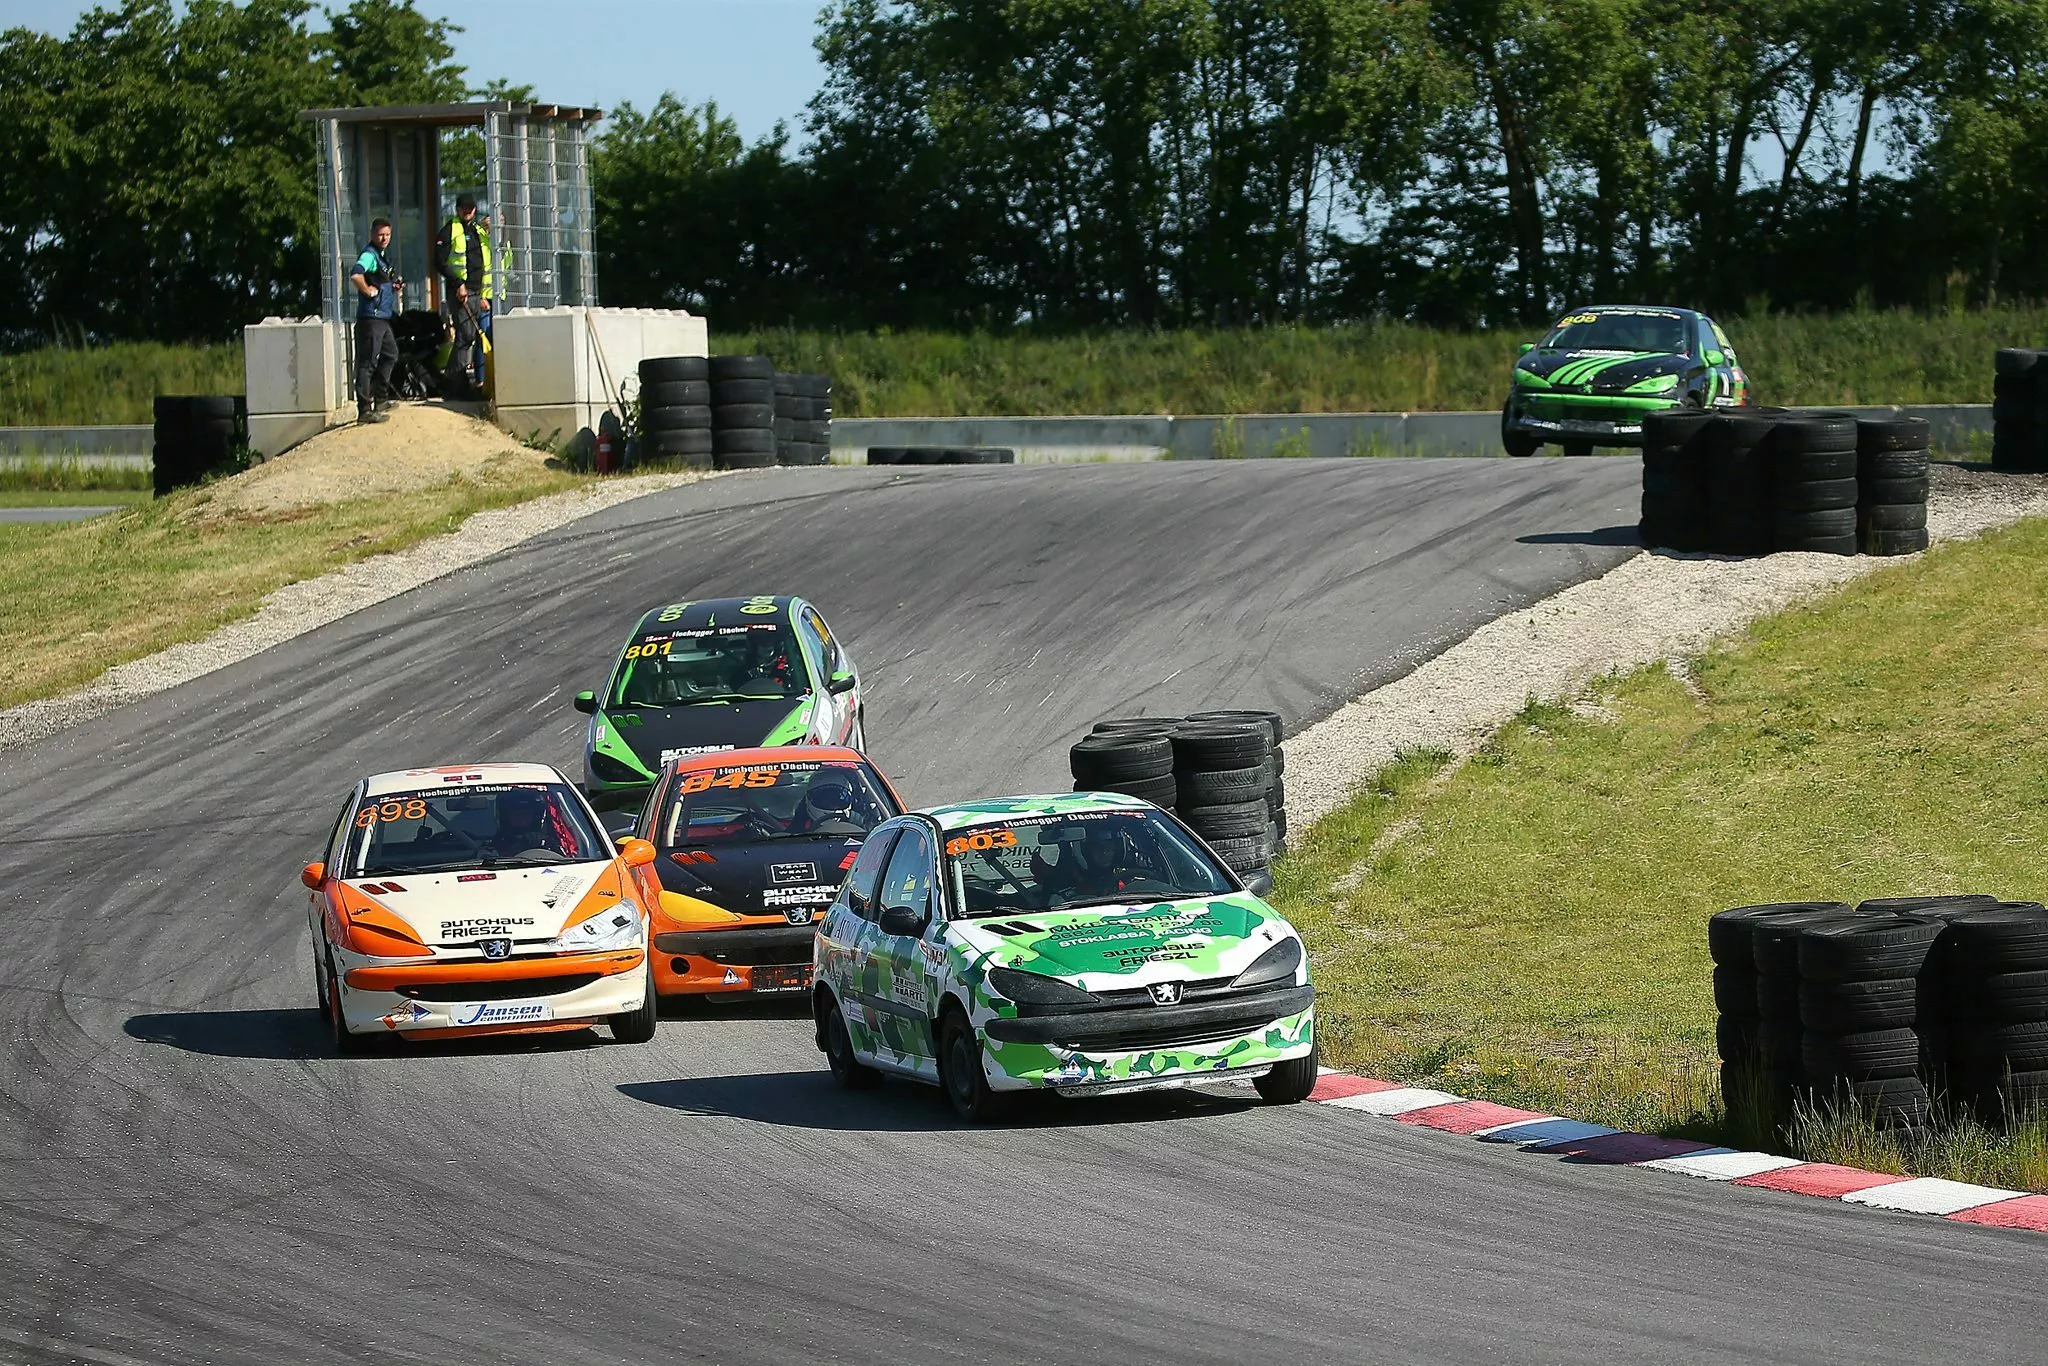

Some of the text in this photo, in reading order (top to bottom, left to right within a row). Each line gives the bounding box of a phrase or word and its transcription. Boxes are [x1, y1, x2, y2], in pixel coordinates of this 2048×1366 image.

[625, 641, 673, 659] 801
[680, 770, 781, 795] 845
[355, 799, 427, 828] 898
[1003, 815, 1063, 829] Hochegger
[946, 831, 1018, 855] 803
[762, 884, 841, 898] AUTOHAU
[763, 893, 834, 907] FRIESZL
[441, 917, 535, 929] AUTOHAUS
[441, 926, 513, 939] FRIESZL
[1058, 926, 1213, 949] STOKLASSA RACING
[1102, 942, 1206, 958] AUTOHAUS
[1119, 952, 1199, 968] FRIESZL
[457, 1004, 543, 1025] Jansen
[479, 1013, 542, 1022] COMPETITION
